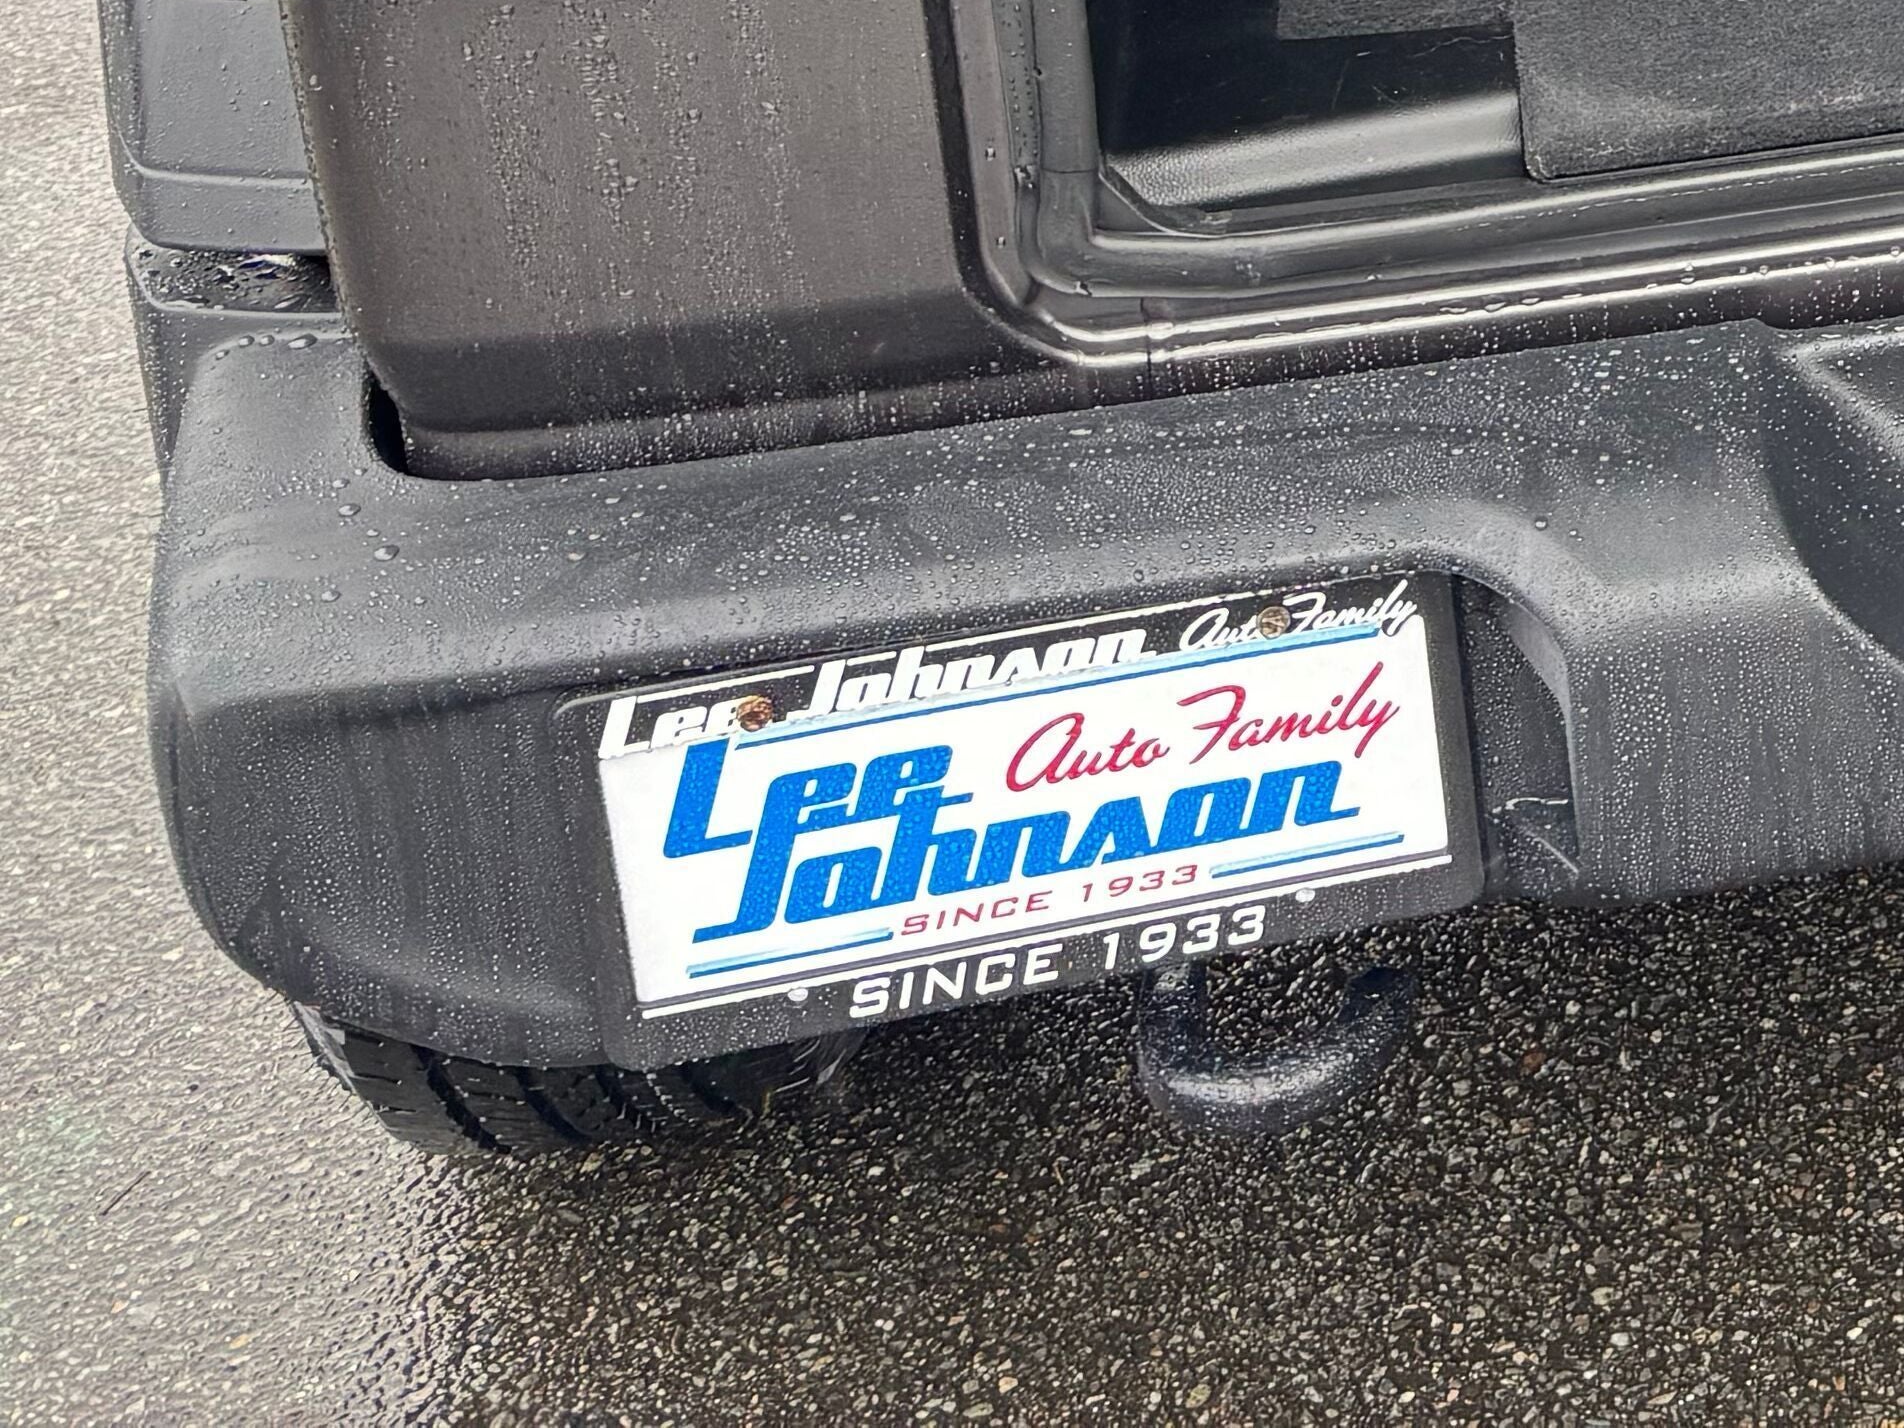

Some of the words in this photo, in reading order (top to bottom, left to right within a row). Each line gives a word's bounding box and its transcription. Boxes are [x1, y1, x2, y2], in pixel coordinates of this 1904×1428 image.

[786, 628, 1158, 723] Johnson
[1179, 607, 1276, 652] Aut
[1282, 579, 1418, 636] Family
[1006, 712, 1171, 792] Auto
[1176, 661, 1401, 765] Family
[663, 738, 954, 860] Lee
[692, 759, 1361, 944] Johnson
[848, 943, 1063, 1019] SINCE
[1102, 905, 1267, 971] 1933
[900, 890, 1054, 936] SINCE
[1081, 864, 1198, 903] 1933
